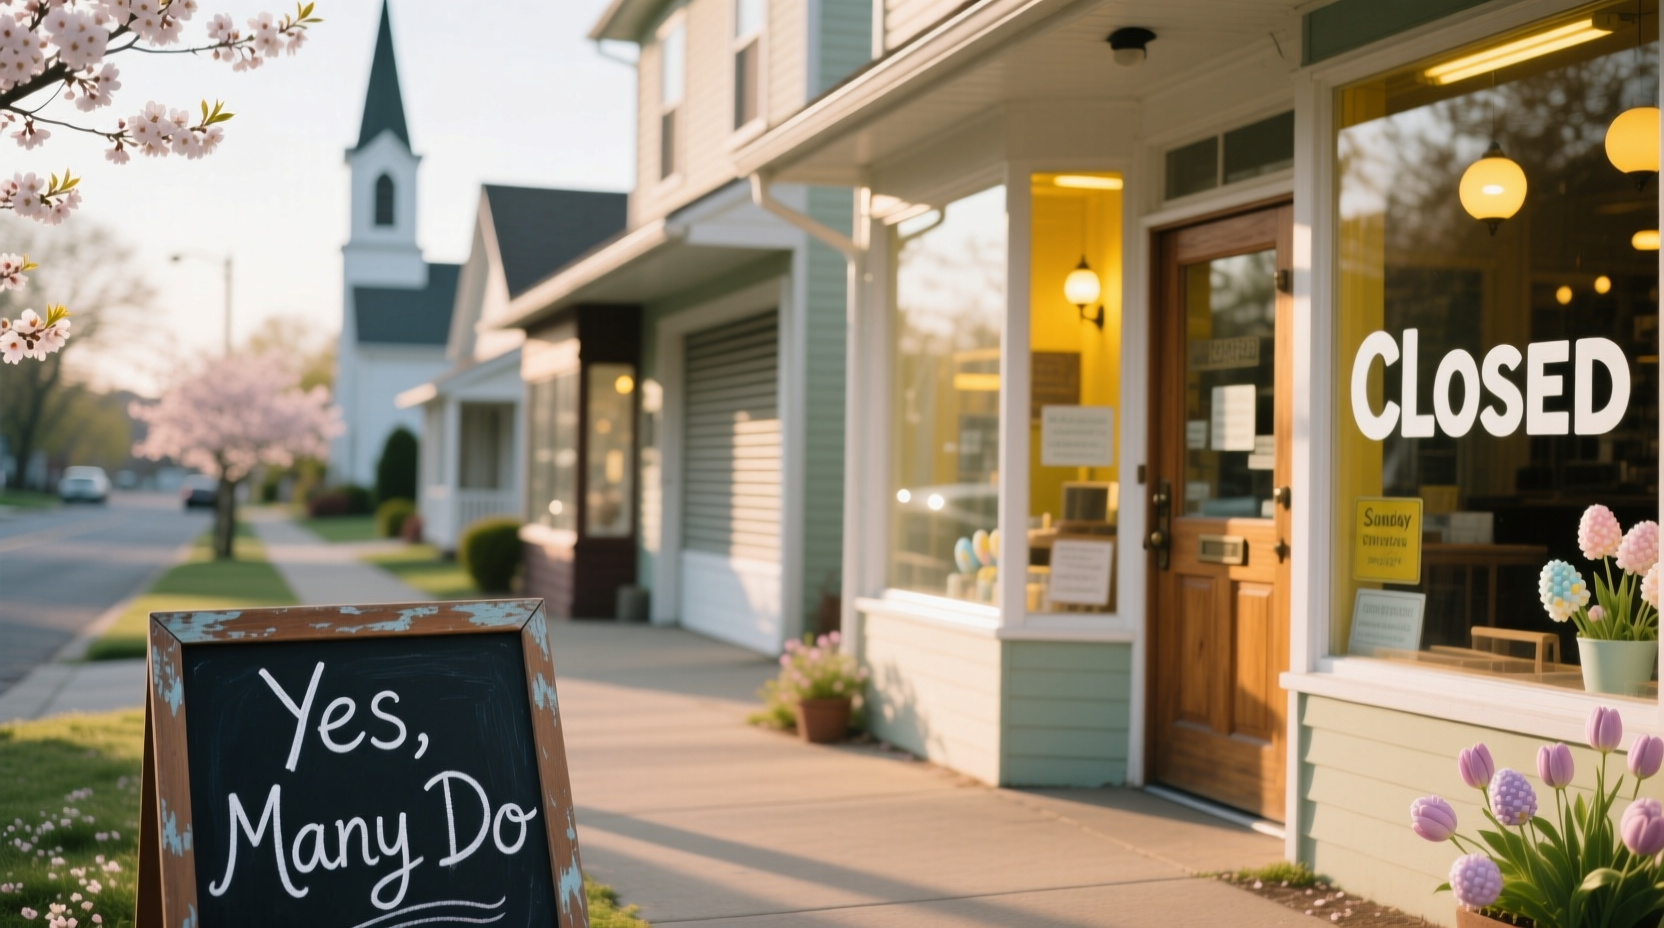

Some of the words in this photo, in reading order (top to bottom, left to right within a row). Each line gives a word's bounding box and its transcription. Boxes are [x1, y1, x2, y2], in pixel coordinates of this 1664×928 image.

[1350, 327, 1631, 441] CLOSED
[258, 661, 429, 772] Yes,
[208, 784, 424, 910] Many
[424, 770, 537, 867] Do
